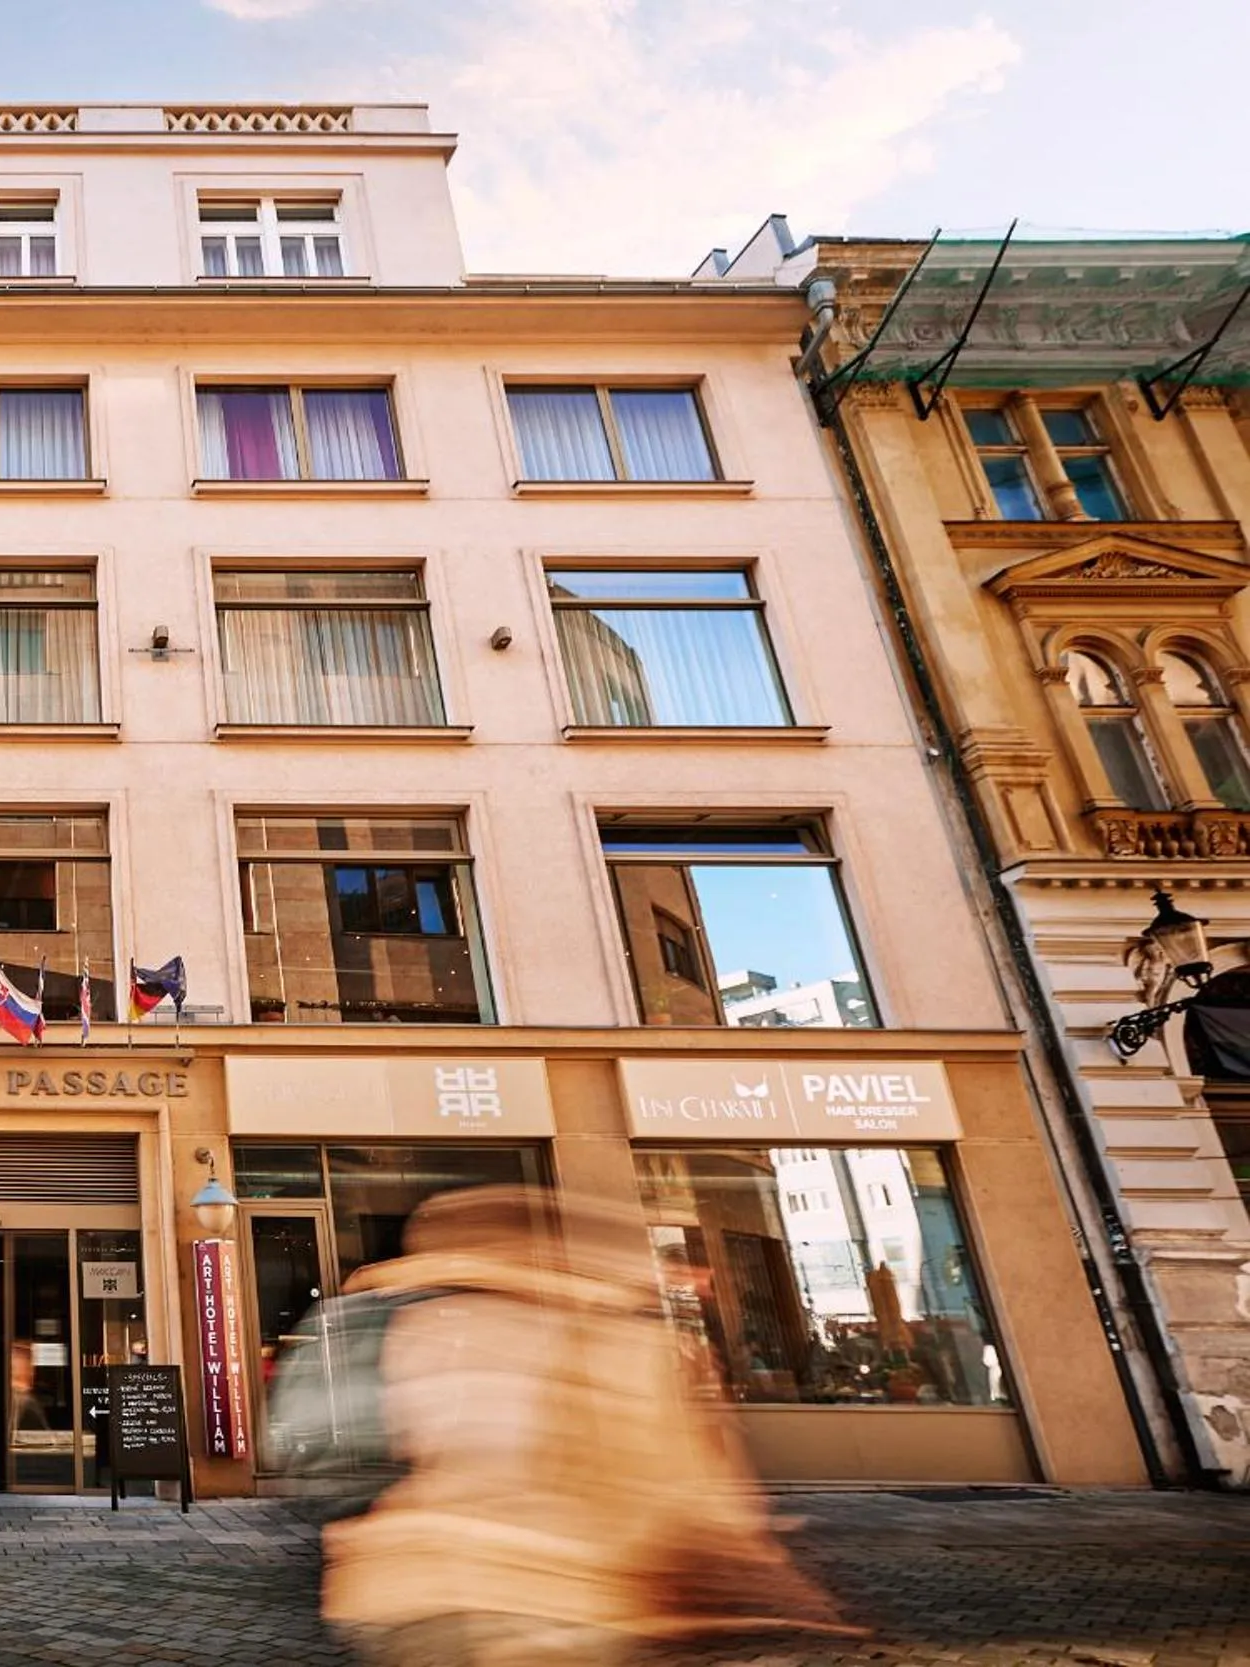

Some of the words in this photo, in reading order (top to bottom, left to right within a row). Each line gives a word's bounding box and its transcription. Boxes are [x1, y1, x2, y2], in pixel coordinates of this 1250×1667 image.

[6, 1070, 189, 1098] PASSAGE
[801, 1074, 932, 1102] PAVIEL
[202, 1254, 214, 1289] ART
[222, 1254, 233, 1290] ART
[205, 1295, 219, 1357] HOTEL
[226, 1297, 238, 1357] HOTEL
[207, 1361, 227, 1453] WILLIAM
[230, 1361, 247, 1453] WILLIAM
